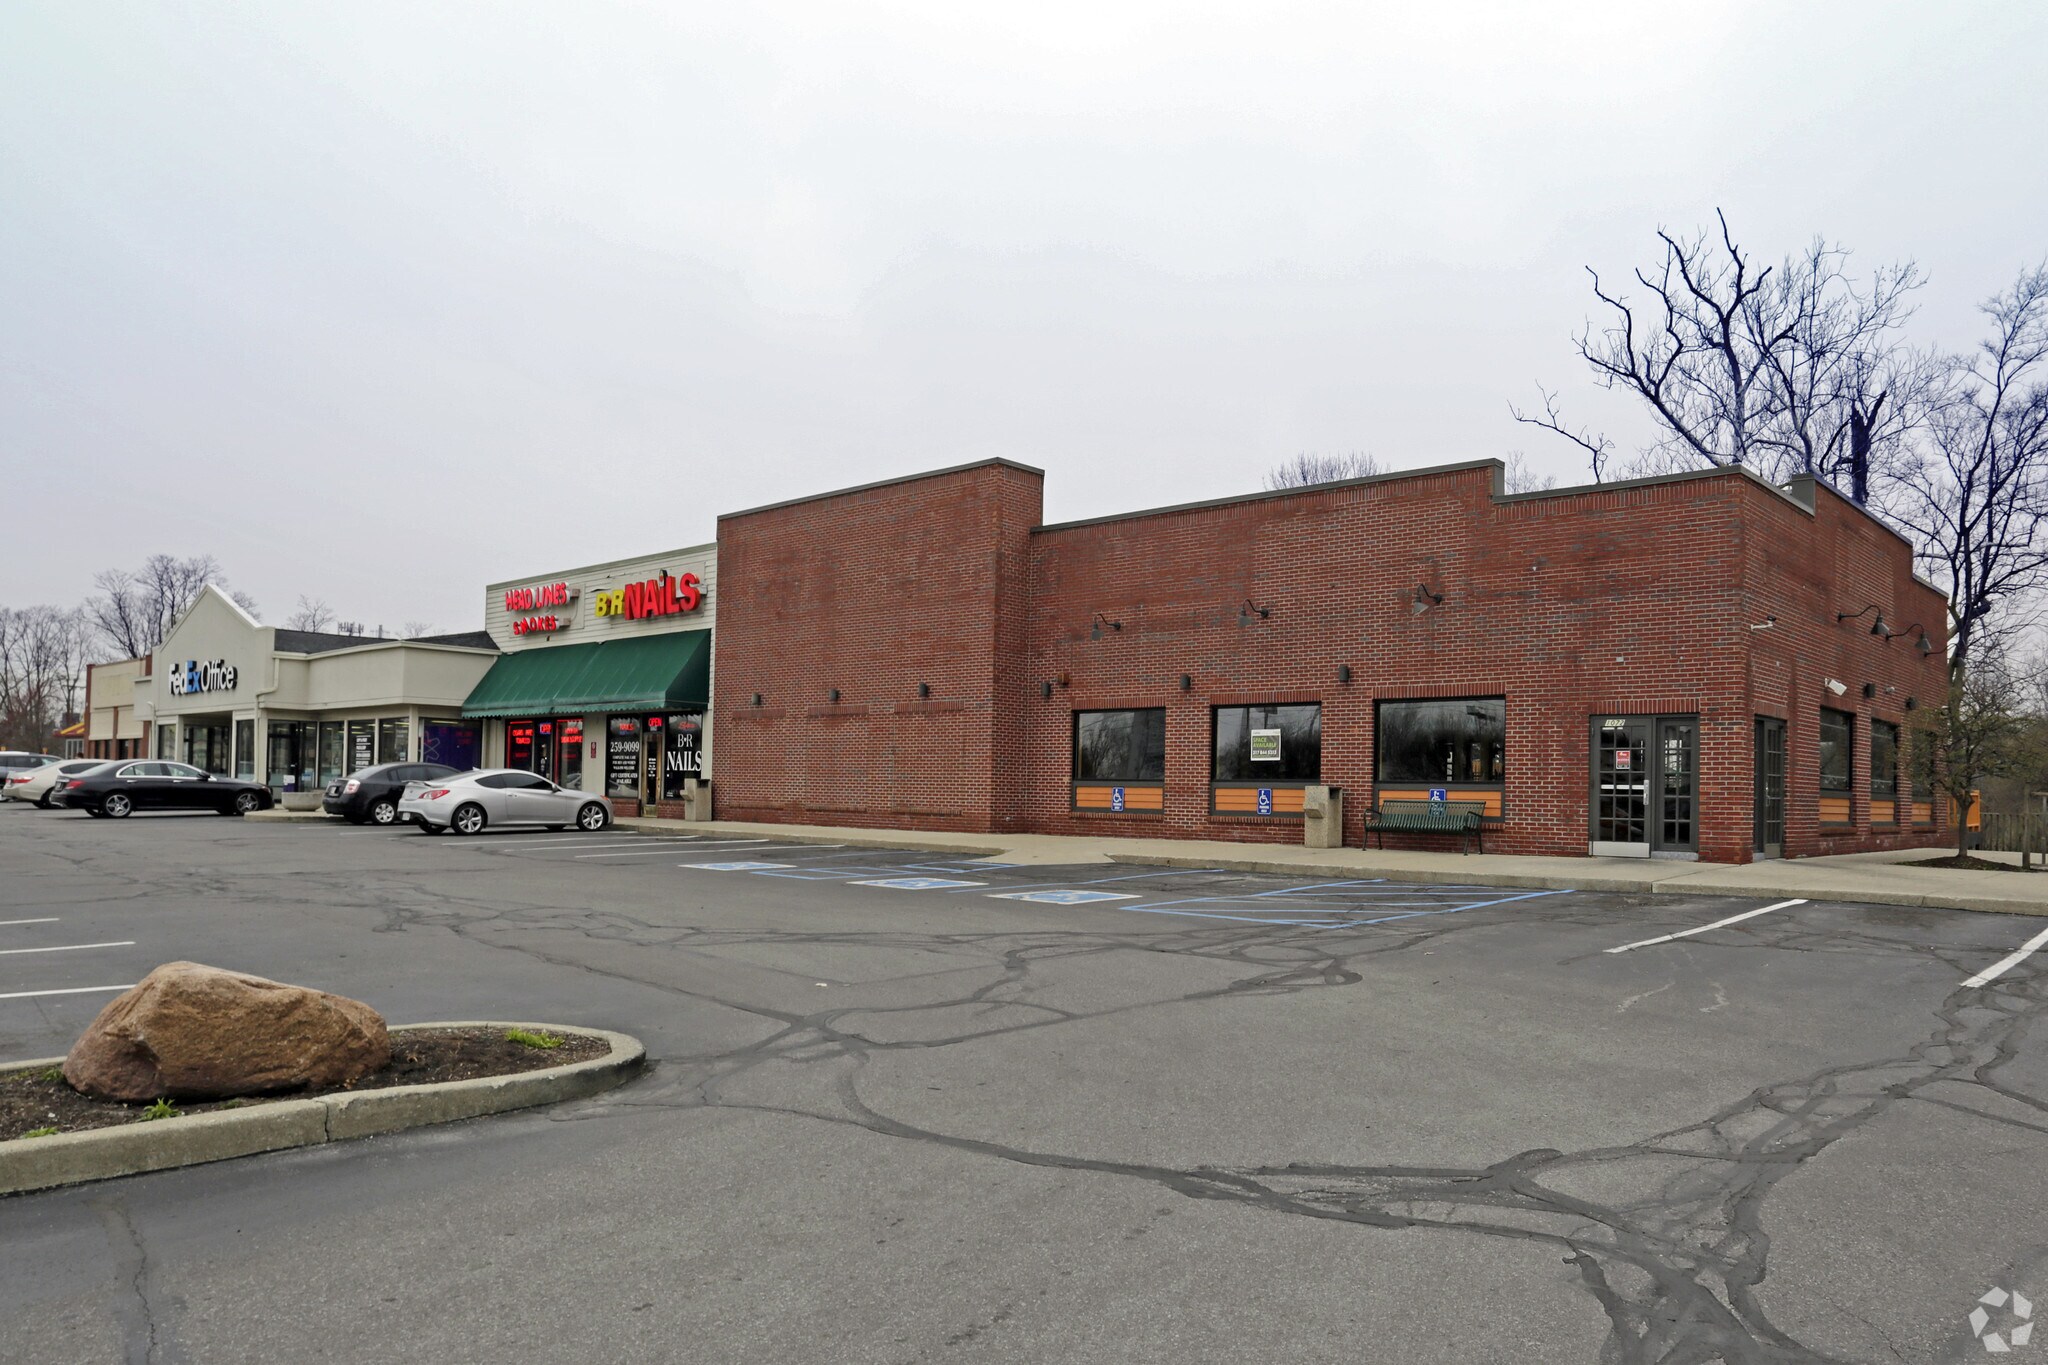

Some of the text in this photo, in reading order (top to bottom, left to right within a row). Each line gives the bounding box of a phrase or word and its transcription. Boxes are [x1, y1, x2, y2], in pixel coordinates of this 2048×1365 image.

[505, 581, 569, 612] HEAD LINES
[513, 614, 558, 635] SMOKES
[169, 658, 237, 695] FedEx Office
[610, 741, 640, 752] 259-9099
[666, 750, 702, 772] NAILS
